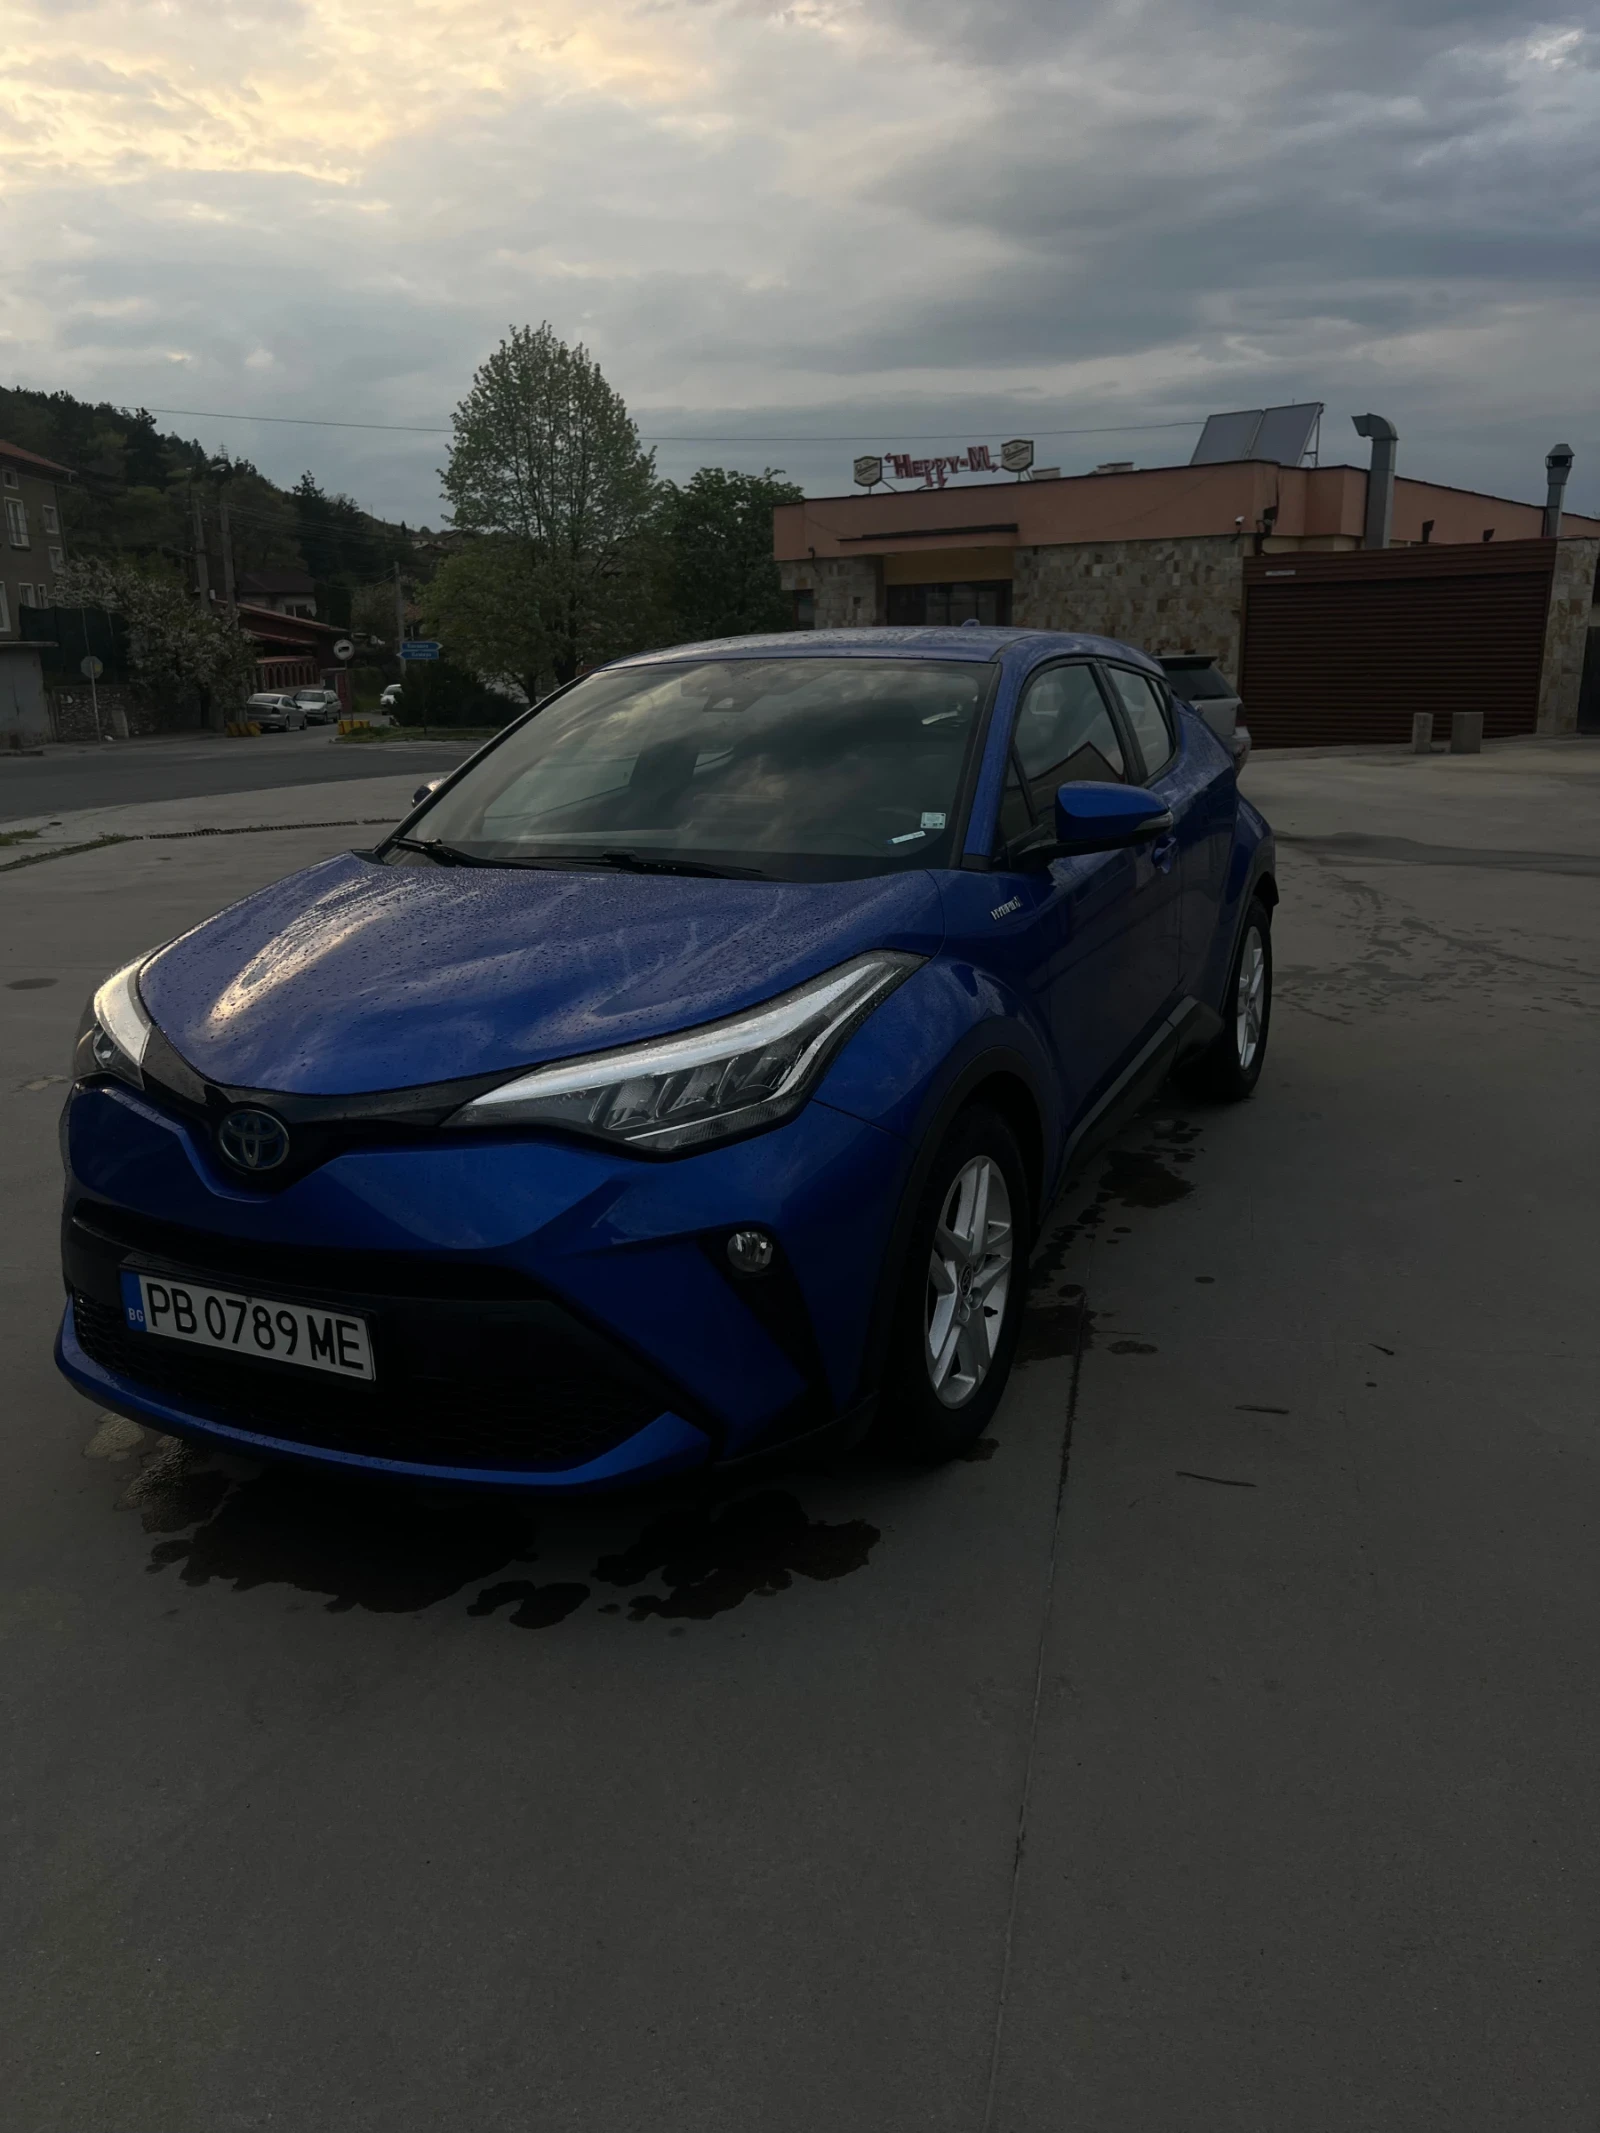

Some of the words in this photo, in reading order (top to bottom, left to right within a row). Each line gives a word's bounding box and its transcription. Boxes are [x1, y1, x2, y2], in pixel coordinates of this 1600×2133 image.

[128, 1307, 144, 1323] BG
[146, 1282, 197, 1335] PB
[204, 1296, 298, 1356] 0789
[307, 1314, 364, 1370] ME
